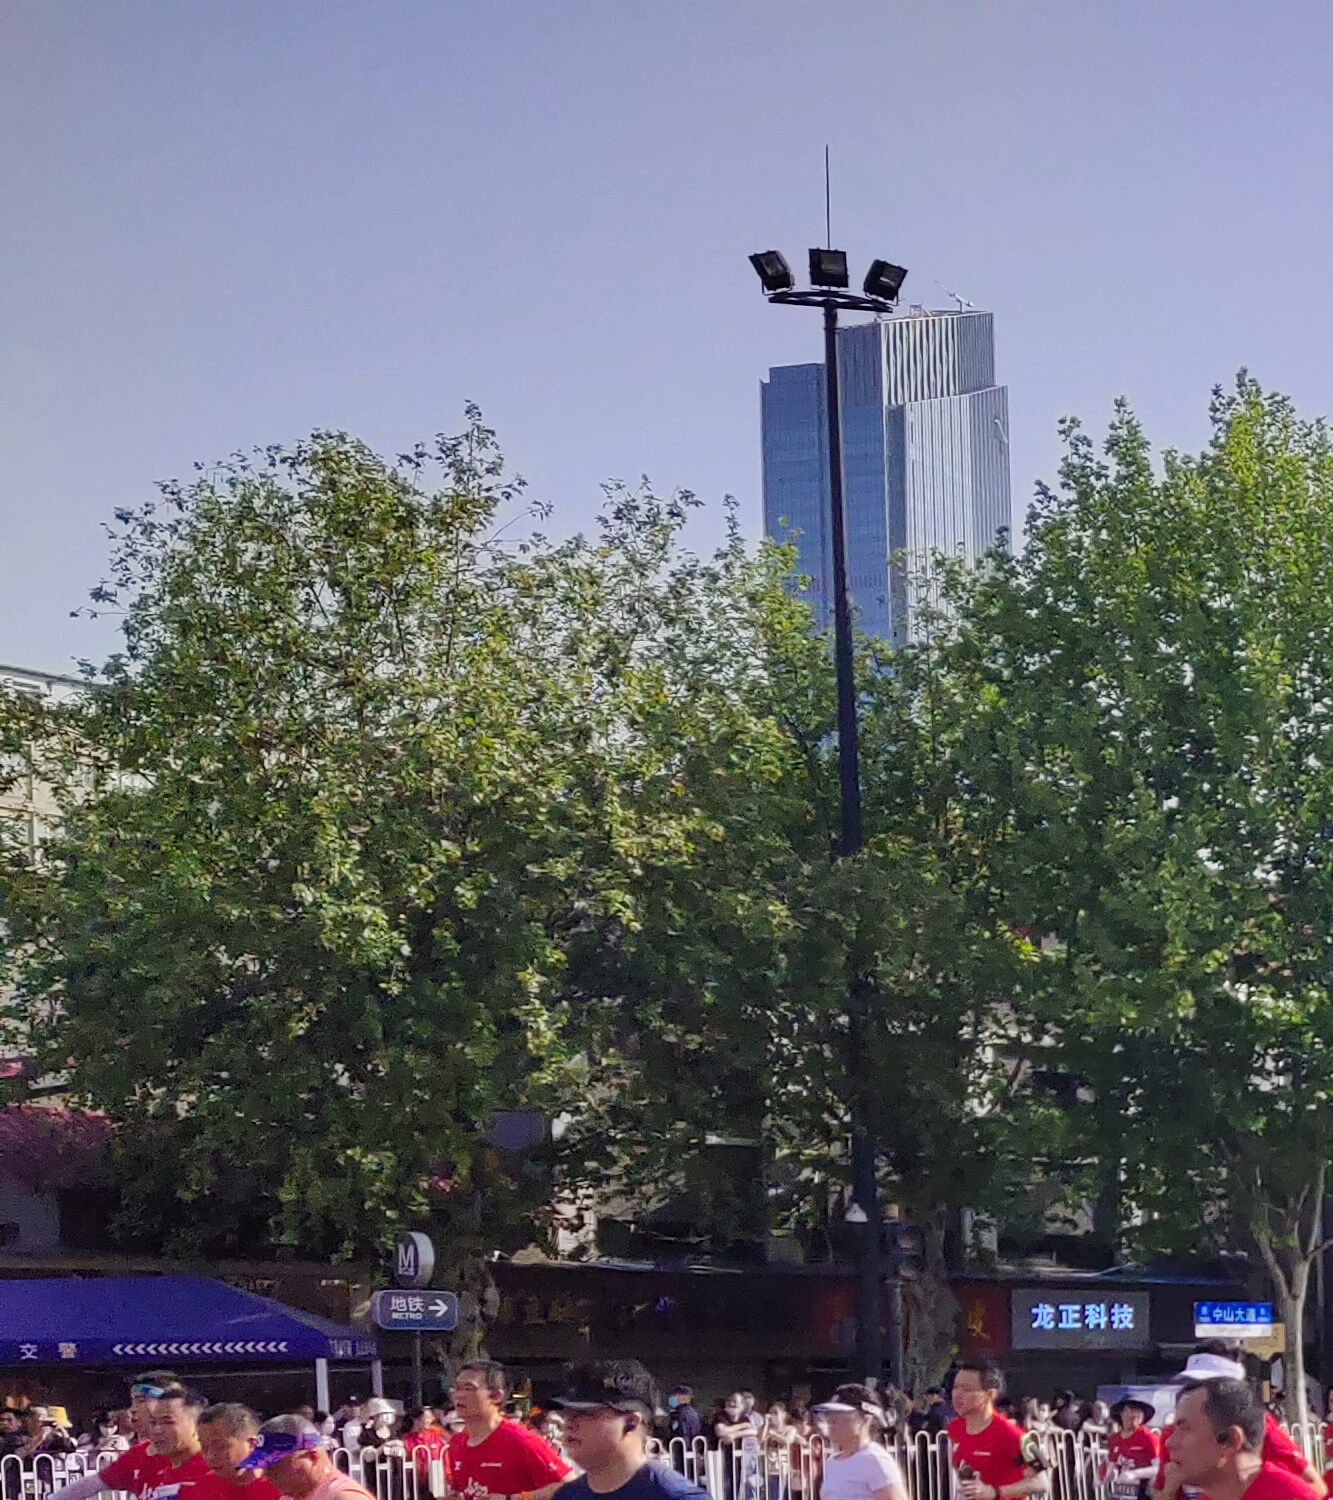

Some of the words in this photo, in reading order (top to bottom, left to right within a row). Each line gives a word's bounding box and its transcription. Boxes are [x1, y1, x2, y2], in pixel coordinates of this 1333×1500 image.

[390, 1295, 425, 1312] 地铁
[1031, 1302, 1135, 1330] 龙正科技
[1212, 1307, 1257, 1322] 中山大道
